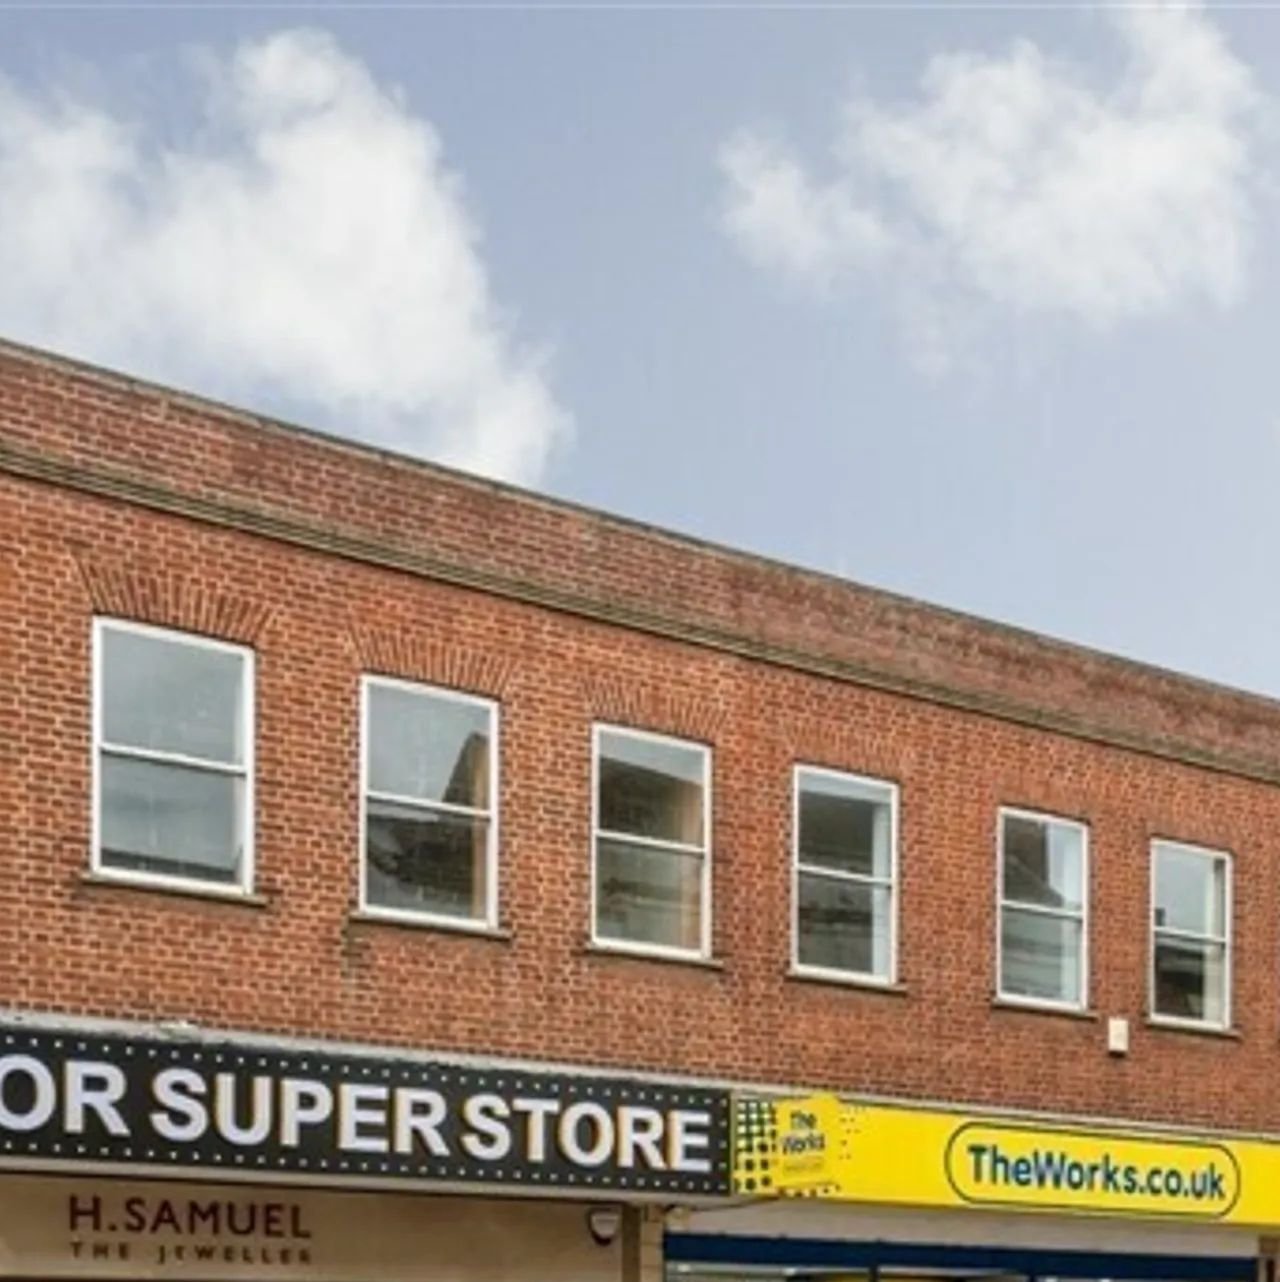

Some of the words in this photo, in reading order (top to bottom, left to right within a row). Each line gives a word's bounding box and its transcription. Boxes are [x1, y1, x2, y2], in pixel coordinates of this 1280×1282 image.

[148, 1066, 451, 1159] SUPER
[459, 1092, 713, 1174] STORE
[967, 1143, 1226, 1201] TheWorks.co.uk
[69, 1194, 313, 1240] H.SAMUEL
[70, 1241, 133, 1261] THE
[157, 1242, 314, 1266] JEWELLER
